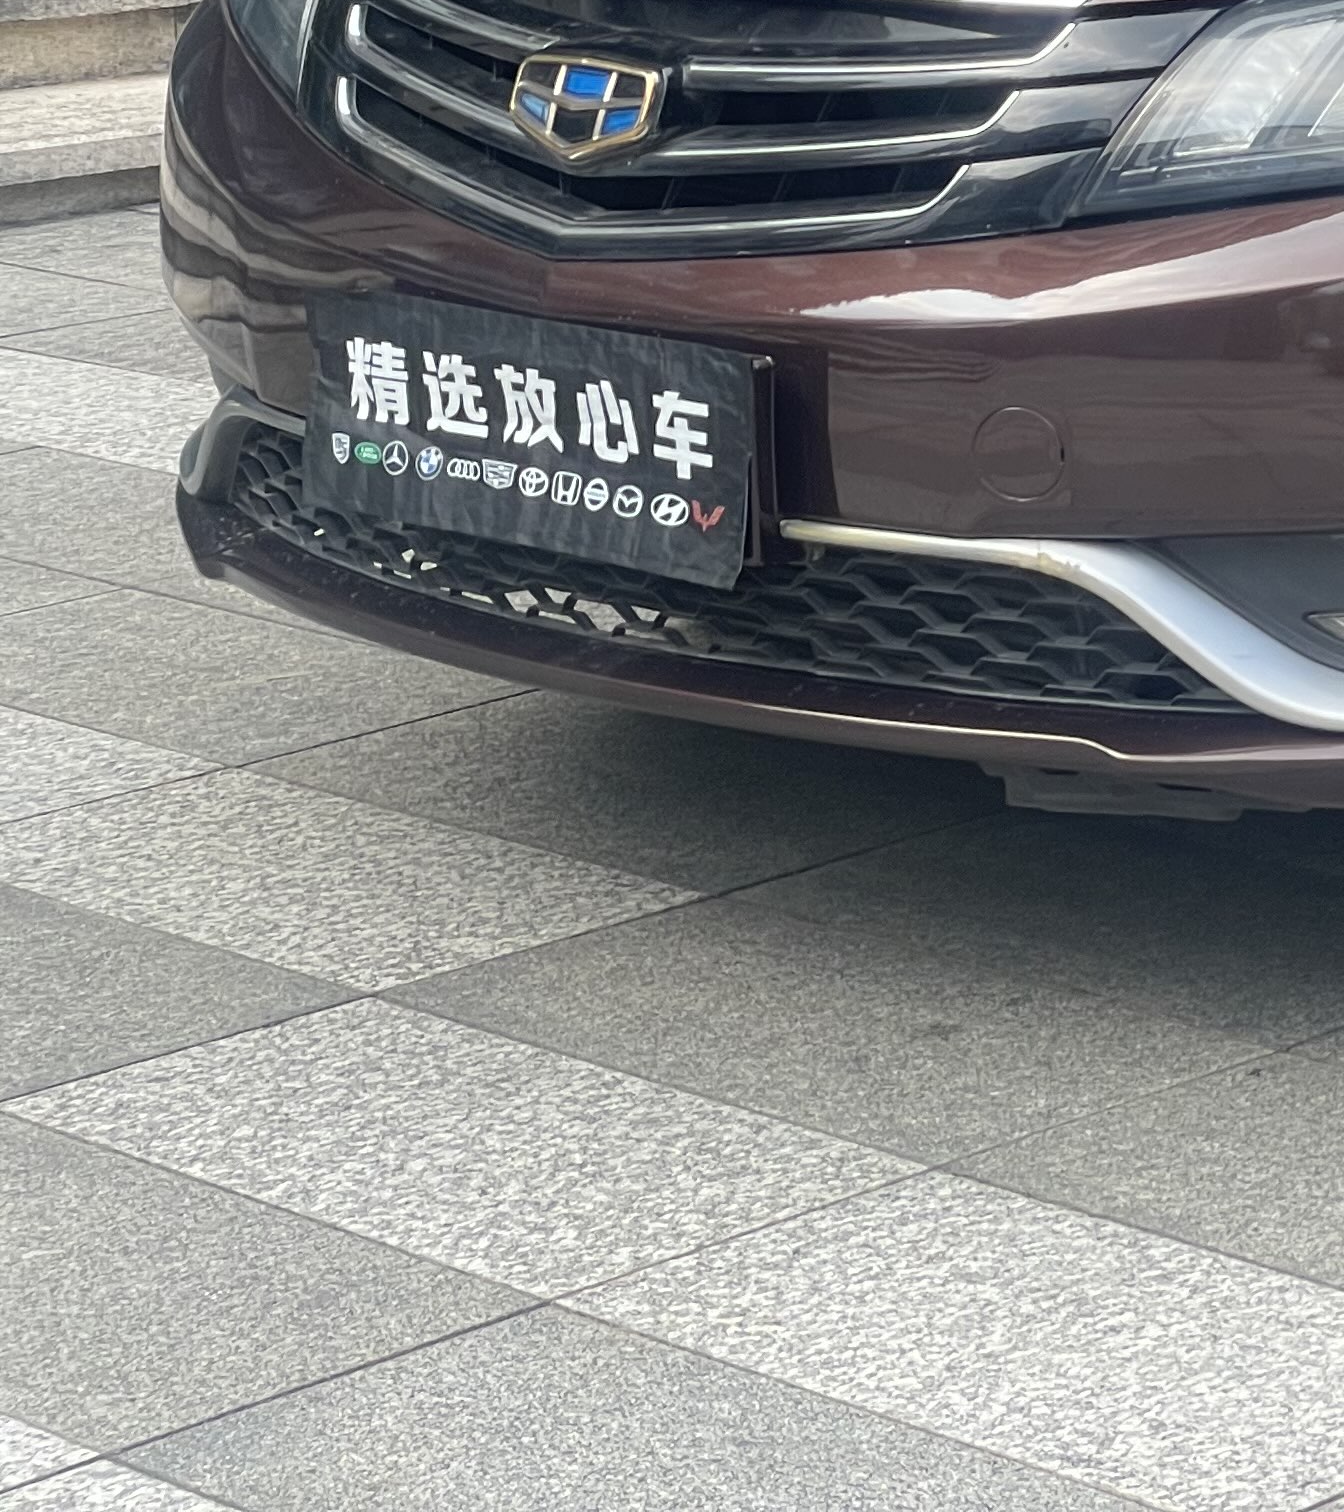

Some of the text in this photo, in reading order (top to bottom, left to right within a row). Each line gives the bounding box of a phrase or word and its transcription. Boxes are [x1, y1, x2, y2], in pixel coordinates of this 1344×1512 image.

[345, 336, 714, 481] 精选放心车
